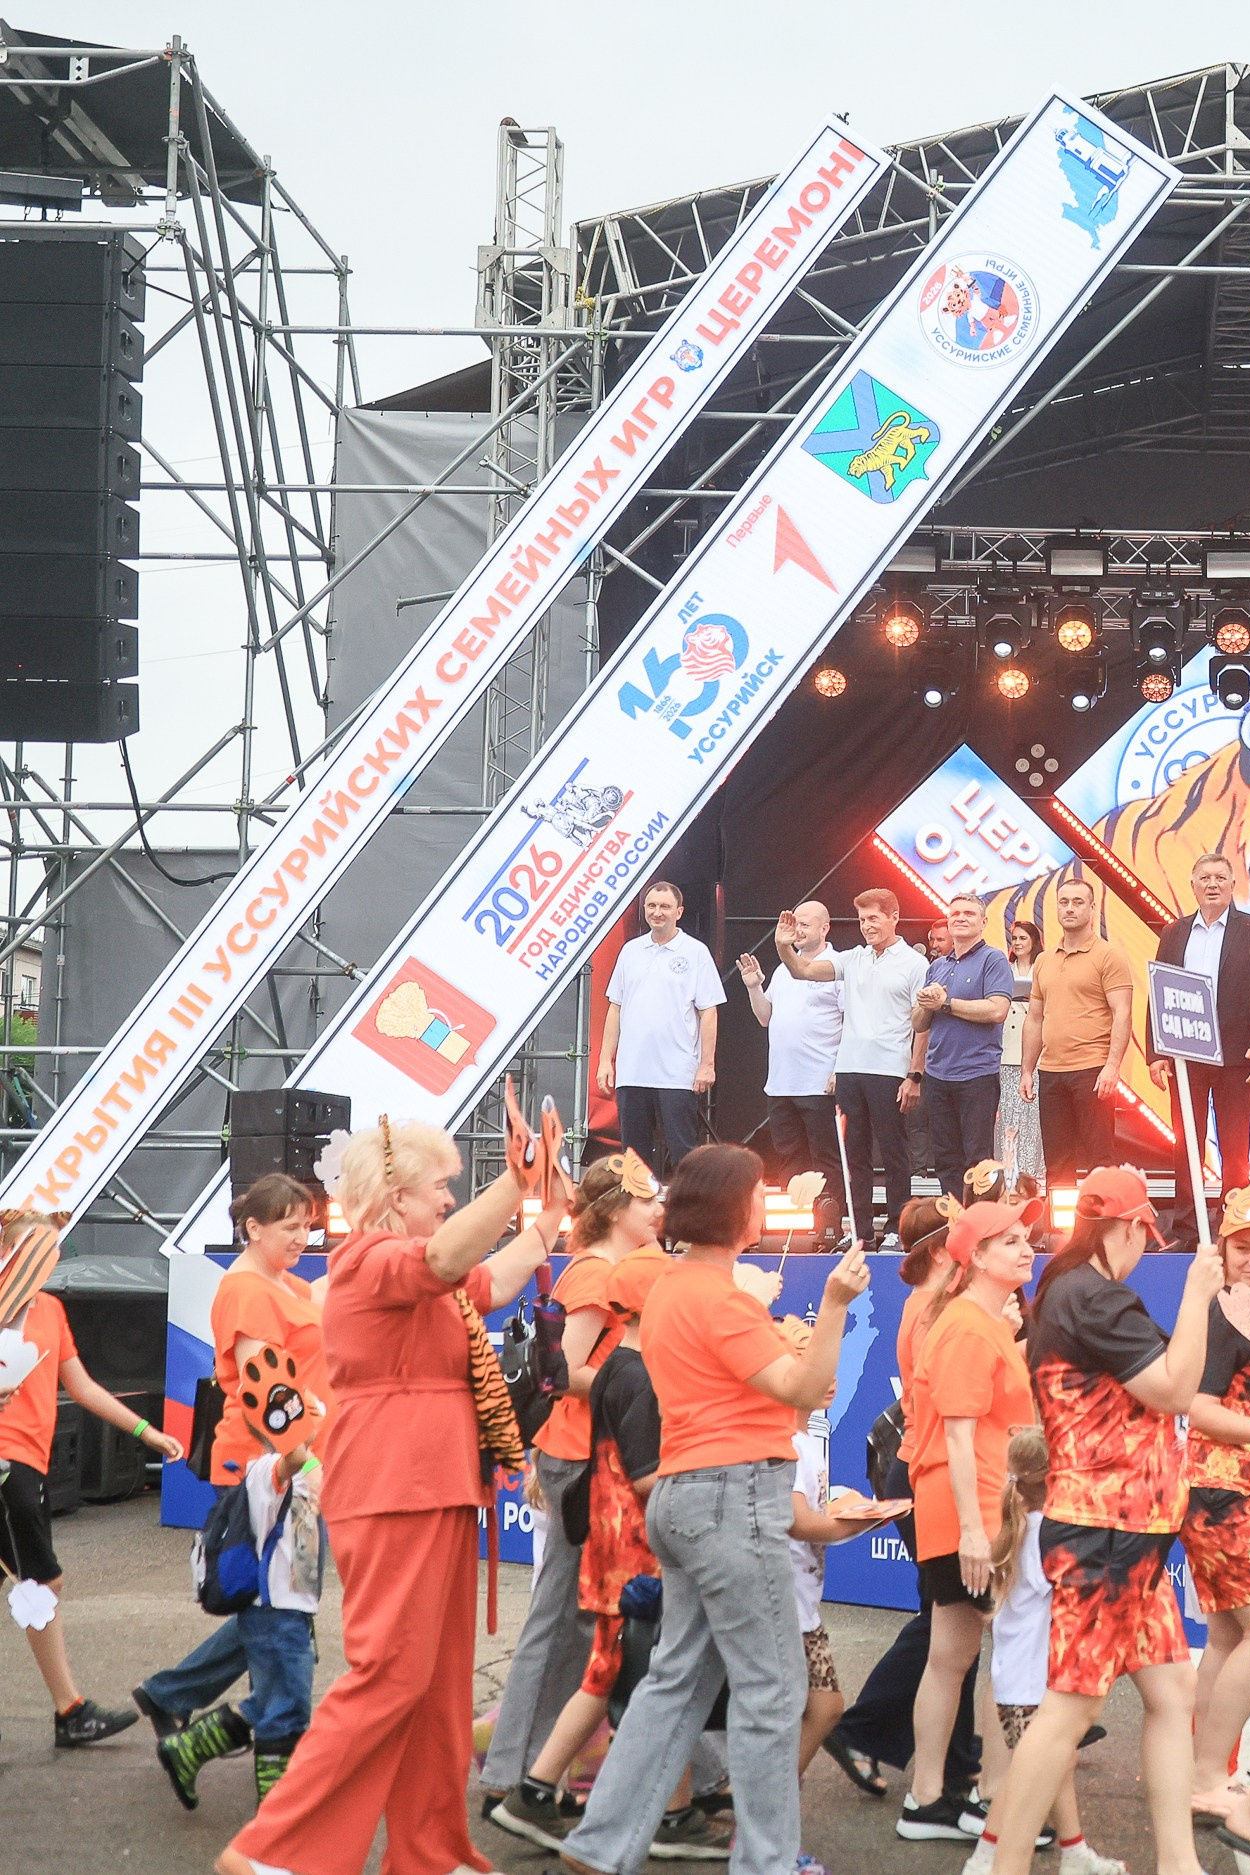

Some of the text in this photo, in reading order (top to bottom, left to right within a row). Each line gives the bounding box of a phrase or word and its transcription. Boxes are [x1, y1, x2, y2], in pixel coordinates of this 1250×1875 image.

[923, 281, 942, 304] 2026
[725, 493, 773, 549] Первые
[677, 591, 704, 624] ЛЕТ
[653, 695, 671, 715] 1866
[662, 702, 682, 722] 2026
[688, 648, 784, 764] УССУРИЙСК
[20, 1028, 179, 1209] КРЫТИЯ
[168, 983, 214, 1037] III
[202, 686, 443, 985] УССУРИЙСКИХ
[435, 455, 621, 684] СЕМЕЙНЫХ
[609, 375, 677, 457] ИГР
[474, 843, 563, 947] 2026
[518, 829, 632, 969] ГОД ЕДИНСТВА
[535, 811, 670, 981] НАРОДОВ РОССИИ
[1161, 1012, 1183, 1039] САД
